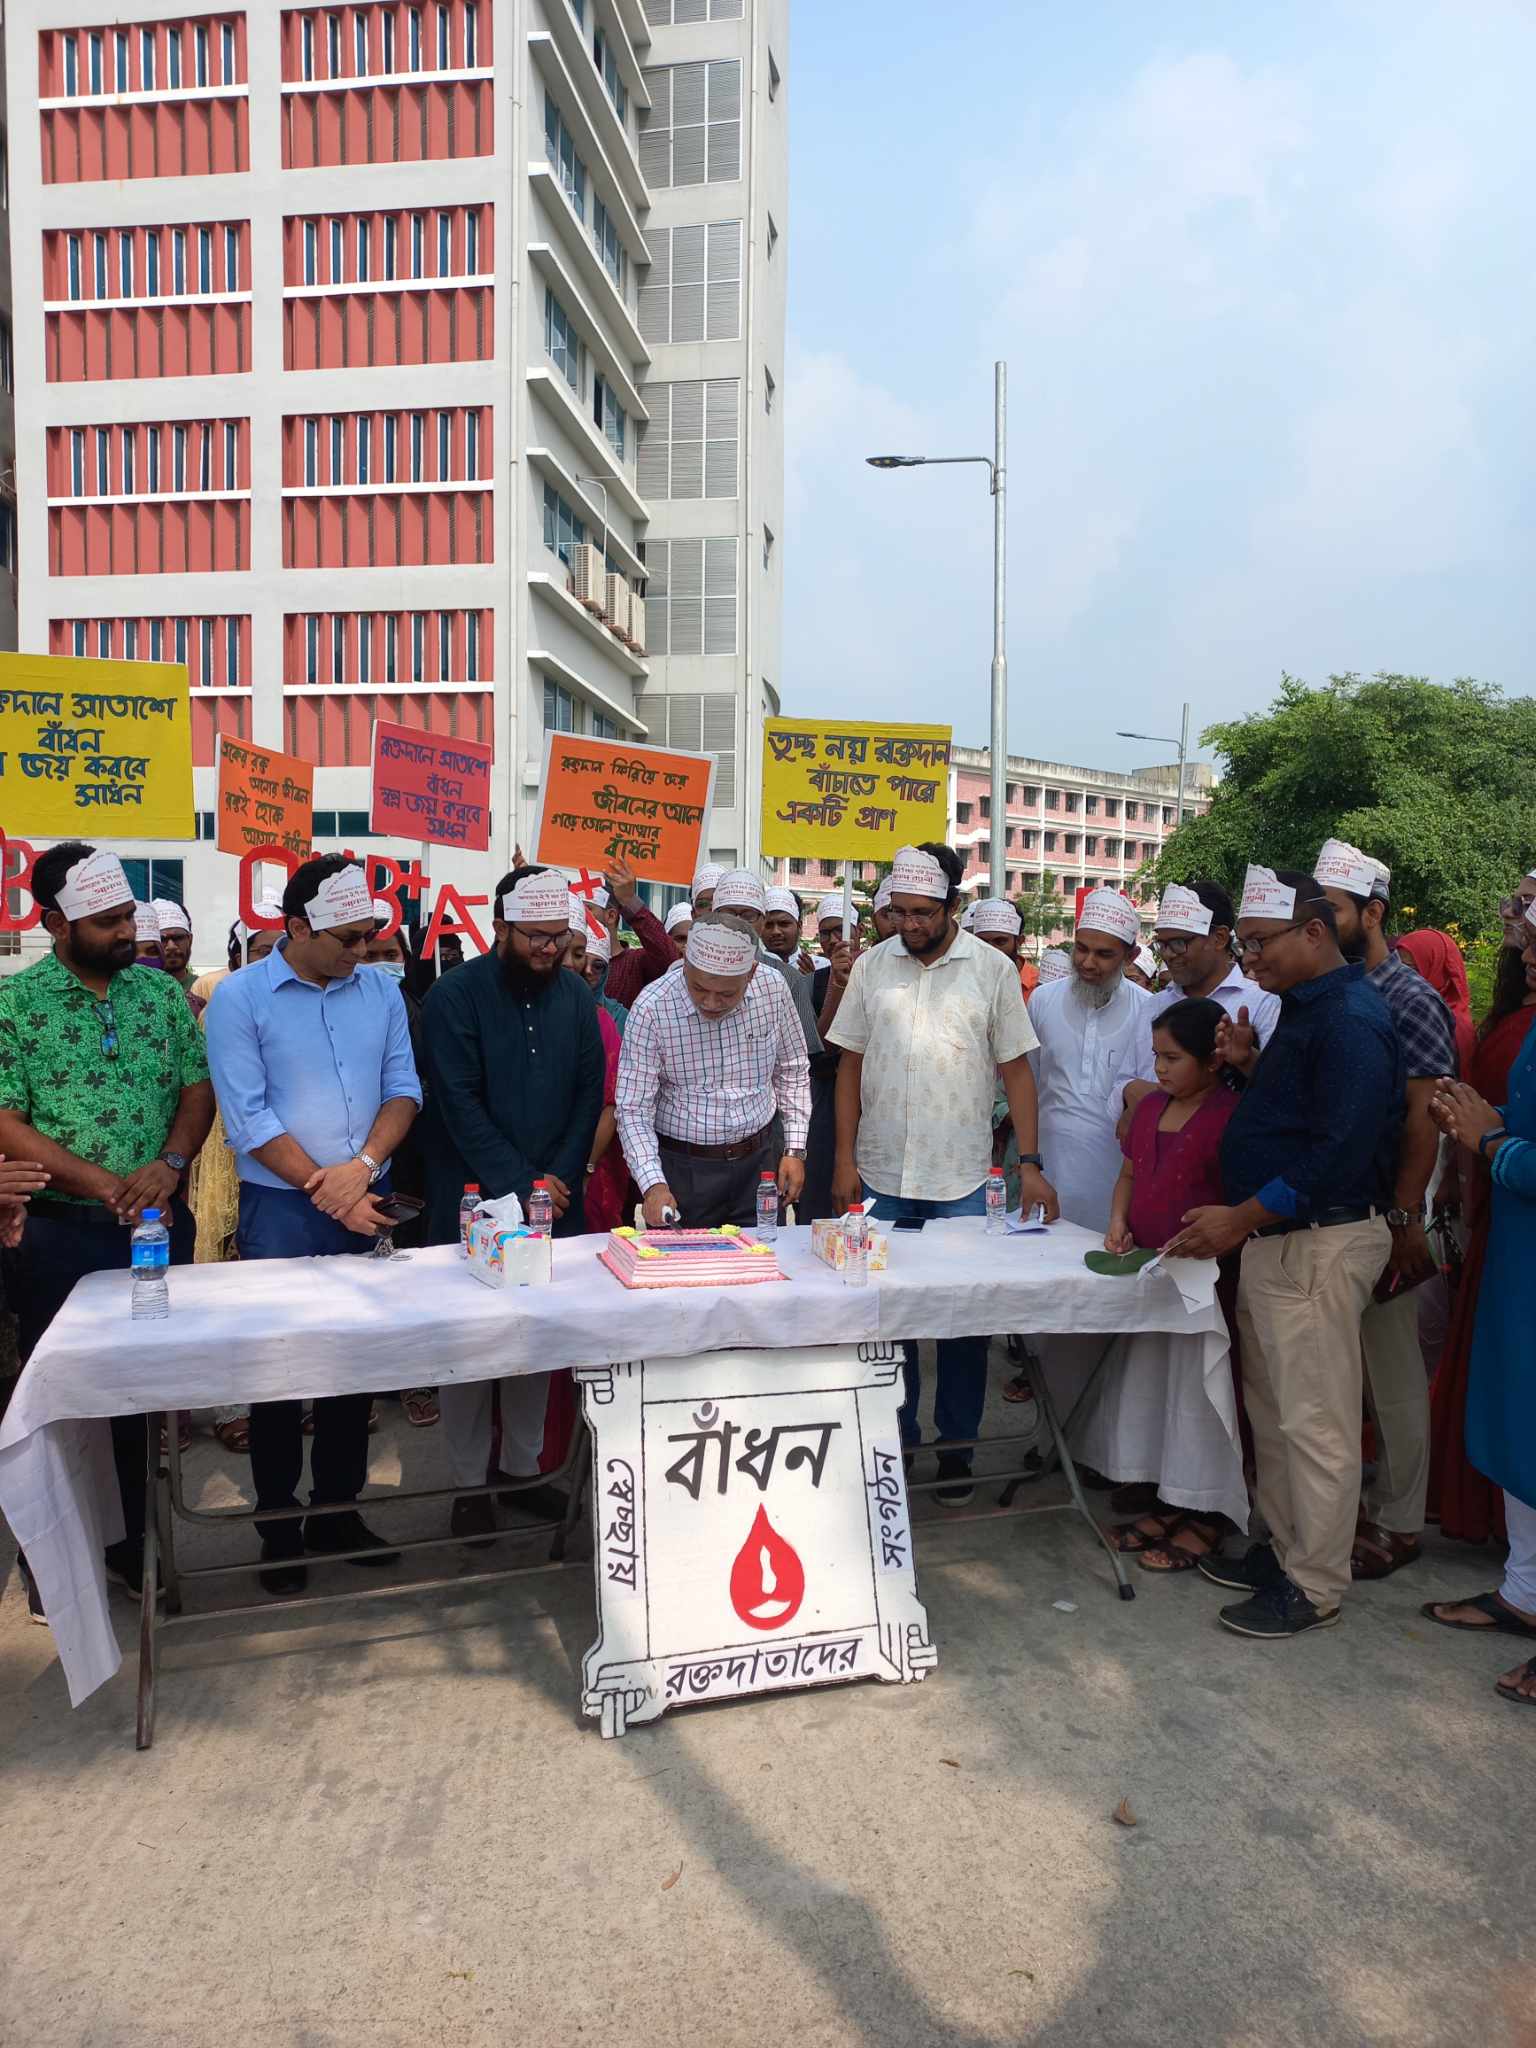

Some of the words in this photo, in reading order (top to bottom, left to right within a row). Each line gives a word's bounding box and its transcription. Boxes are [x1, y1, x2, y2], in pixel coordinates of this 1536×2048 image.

[0, 690, 63, 716] দানে
[71, 692, 178, 720] সাতাশে
[37, 720, 105, 753] বাঁধন
[768, 731, 818, 763] তুচ্ছ
[824, 734, 870, 765] নয়
[874, 736, 951, 768] রক্তদান
[18, 752, 75, 781] জয়
[83, 755, 151, 782] করবে
[610, 757, 660, 785] ফিরিয়ে
[806, 762, 880, 795] বাঁচাতে
[886, 775, 941, 803] পারে
[74, 783, 144, 807] সাধন
[592, 784, 661, 819] জীবনের
[776, 793, 850, 827] একটি
[854, 806, 898, 831] প্রাণ
[604, 834, 660, 859] বাঁধন
[664, 1401, 842, 1501] বাঁধন
[605, 1458, 639, 1591] স্বেচ্ছায়
[867, 1446, 907, 1569] সংগঠন
[665, 1637, 864, 1699] রক্তদাতাদের
